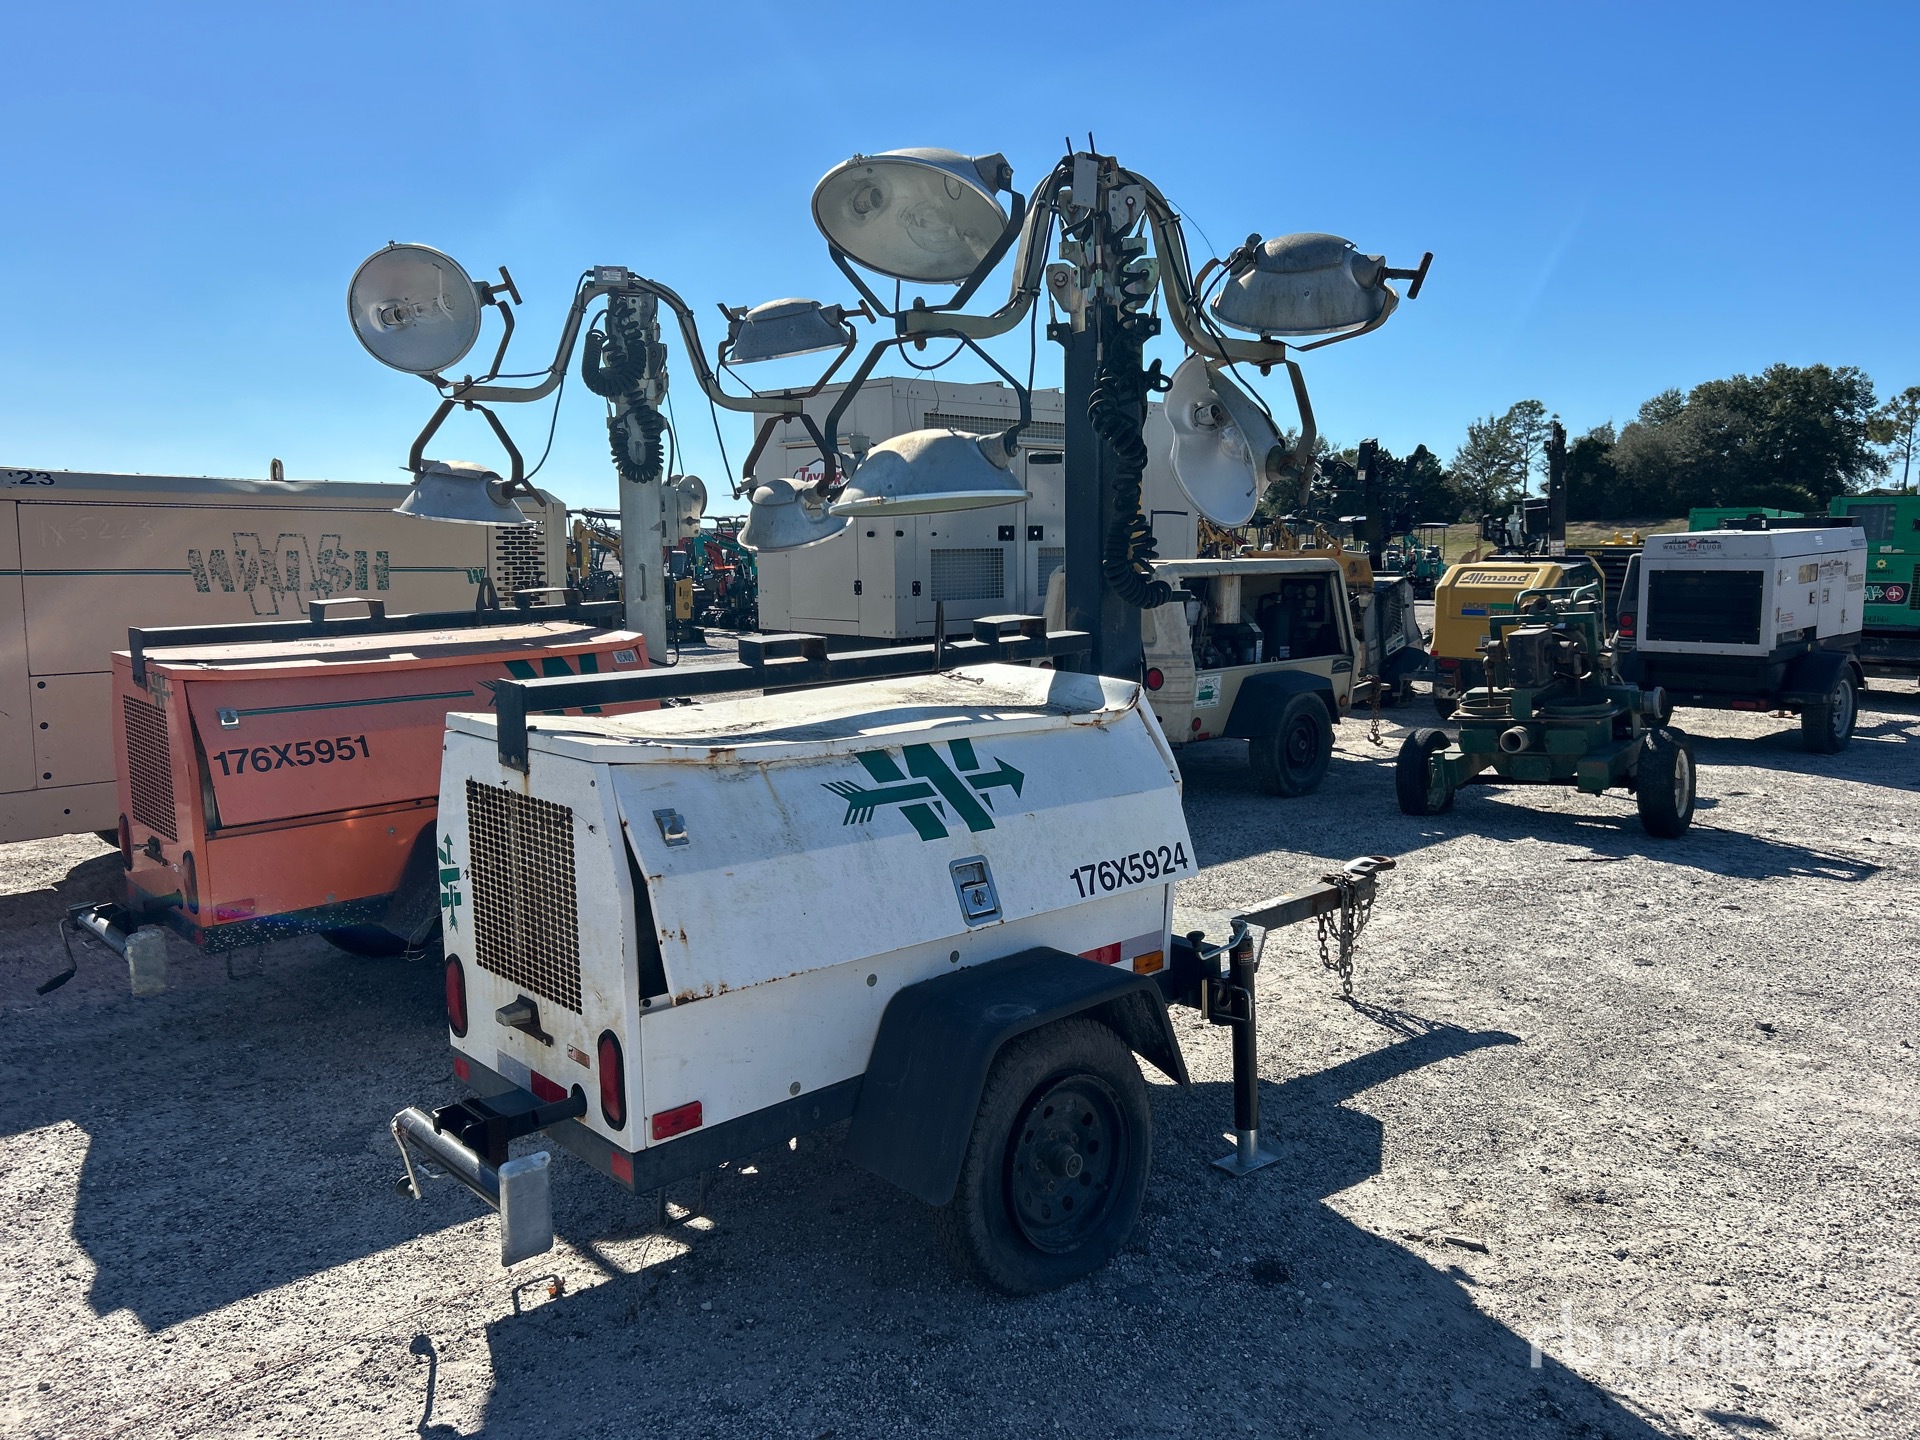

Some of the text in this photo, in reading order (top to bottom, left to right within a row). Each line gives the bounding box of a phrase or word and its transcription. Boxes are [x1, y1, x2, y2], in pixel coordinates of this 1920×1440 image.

[799, 467, 842, 485] TAYLR
[187, 549, 390, 592] WALSH
[1460, 572, 1530, 584] Allmand
[213, 735, 370, 776] 176X5951
[1069, 841, 1189, 898] 176X5924
